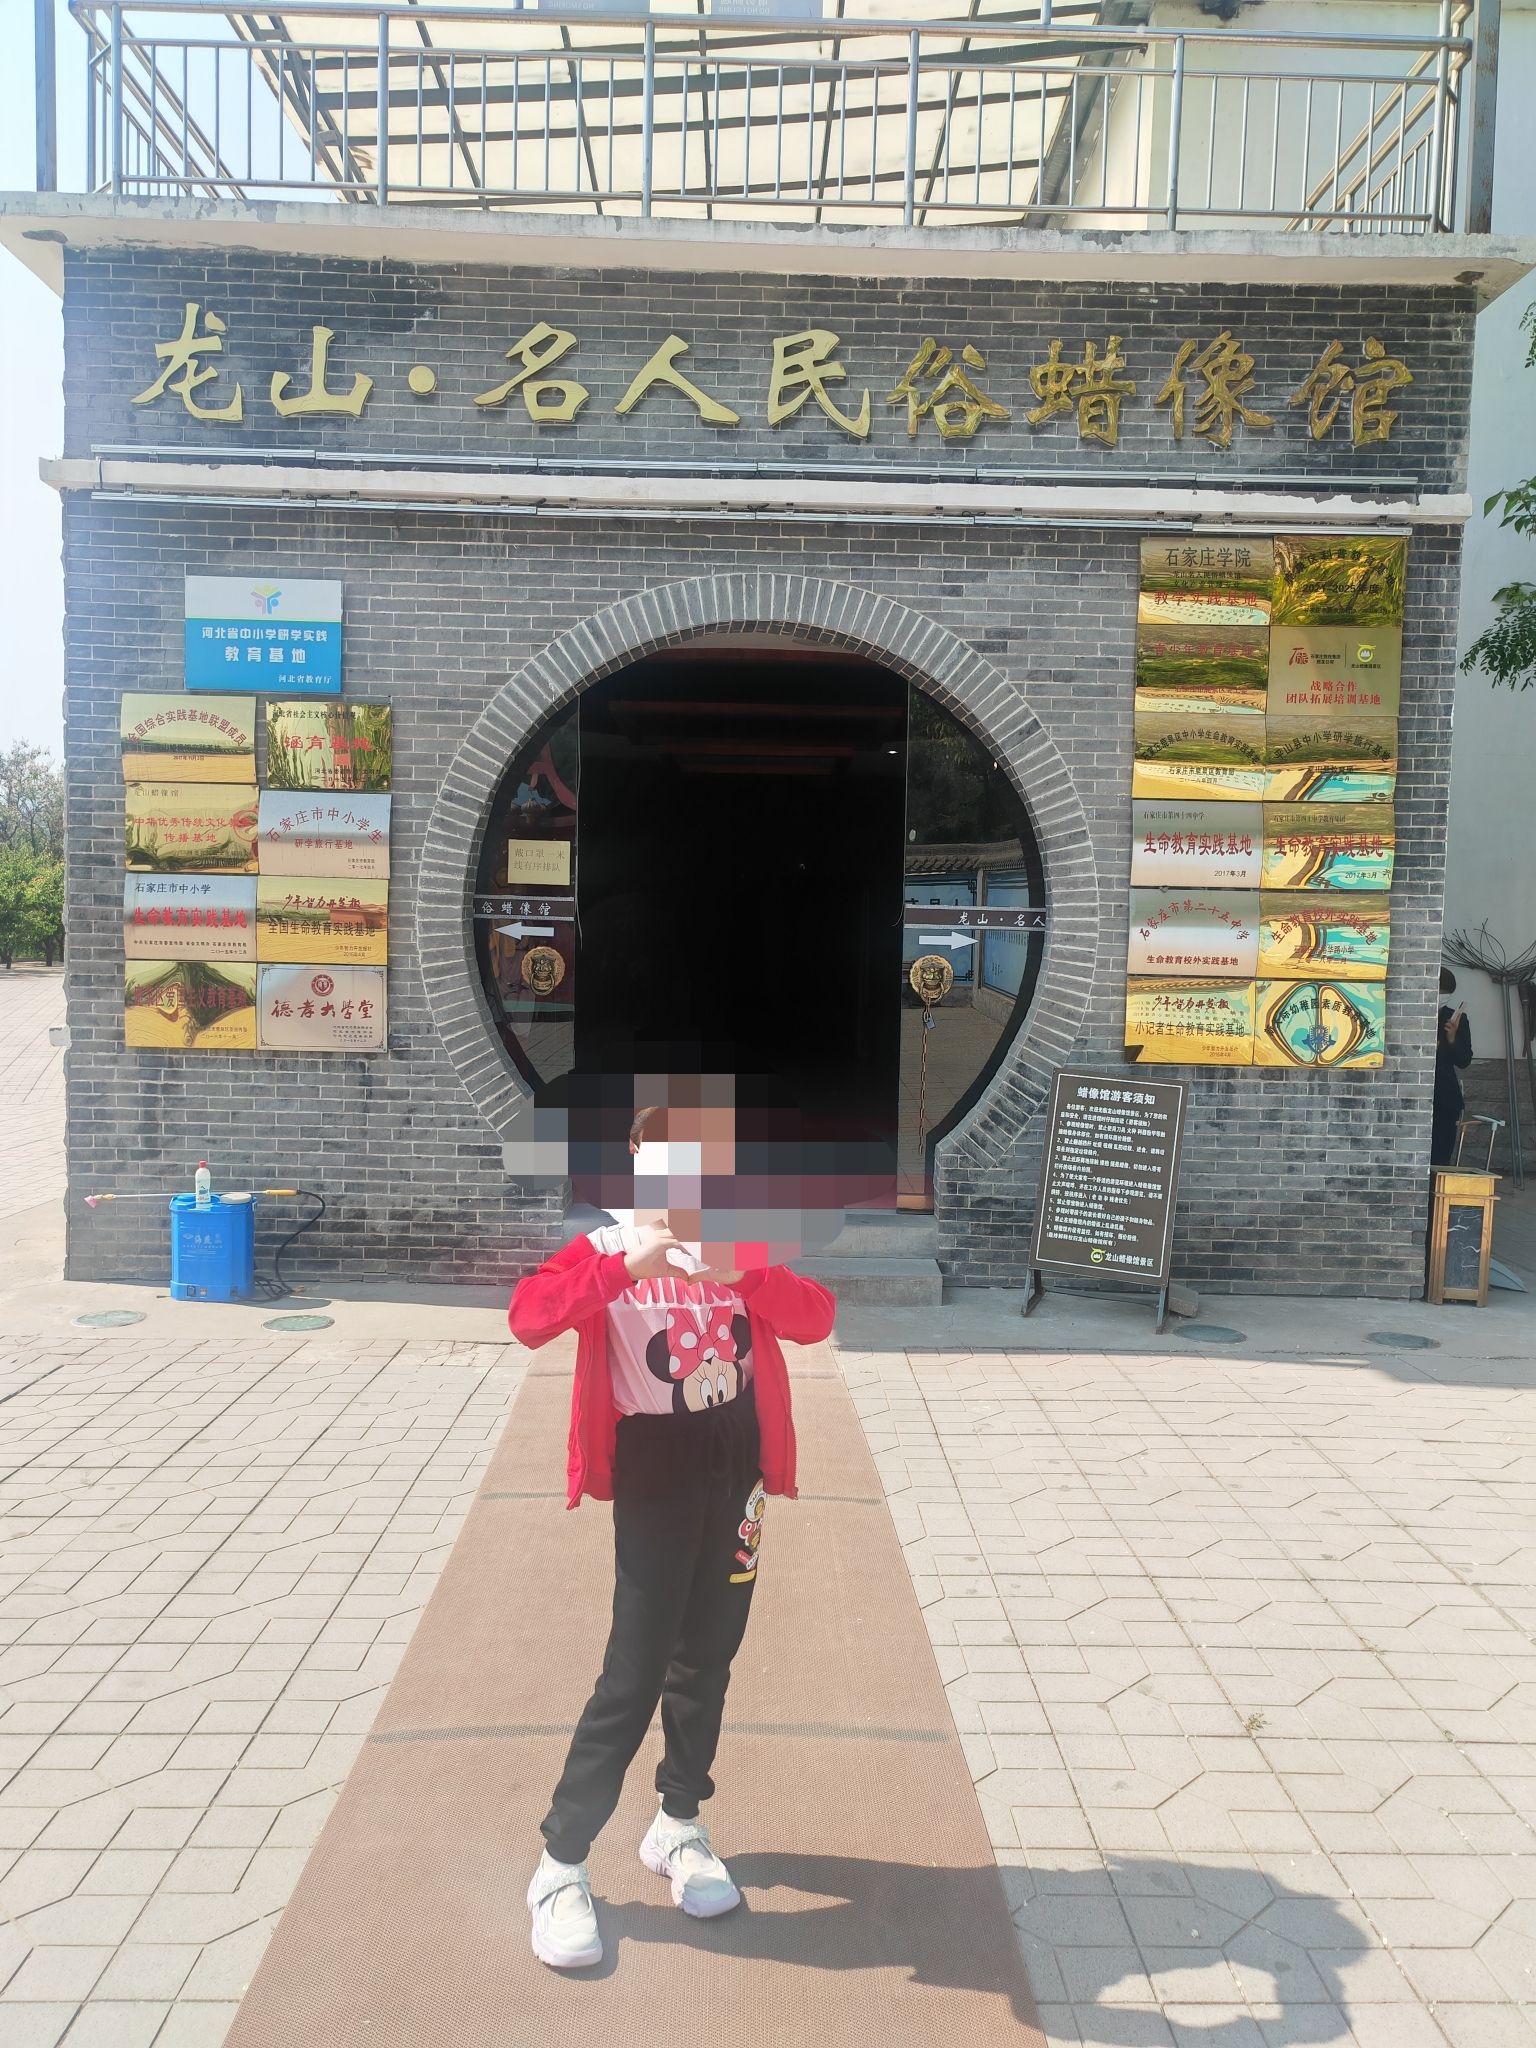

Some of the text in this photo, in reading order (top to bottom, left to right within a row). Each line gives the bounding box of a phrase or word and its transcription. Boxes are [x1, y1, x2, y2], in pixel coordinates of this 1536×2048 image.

[1165, 547, 1251, 568] 石家庄学院
[1154, 590, 1257, 607] 教学实践基地
[201, 626, 328, 642] 河北省中小学研学实践
[225, 646, 306, 664] 教育基地
[278, 674, 332, 685] 河北省教育厅
[1310, 681, 1357, 692] 战略合作
[1286, 692, 1381, 705] 团队拓展培训基地
[127, 708, 247, 746] 全国综合实践基地联盟成员
[1273, 731, 1391, 762] 平山县中小学研学旅行基地
[265, 806, 383, 846] 石家庄市中小学生
[164, 833, 217, 843] 传播基地
[295, 838, 354, 850] 研学旅行基地
[1143, 831, 1253, 857] 生命教育实践基地
[1273, 833, 1384, 858] 生命教育实践基地
[1214, 870, 1246, 878] 2017年3月
[135, 882, 212, 895] 石家庄市中小学
[482, 901, 551, 915] 俗蜡像馆
[133, 906, 248, 929] 生命教育实践基地
[1139, 898, 1250, 941] 石家庄市第二十五中学
[268, 919, 376, 937] 全国生命教育实践基地
[1270, 908, 1377, 946] 生命教育校外实践基地
[1146, 955, 1239, 966] 生命教育校外实践基地
[1135, 1020, 1245, 1037] 小记者生命教育实践基地
[1077, 1086, 1156, 1105] 蜡像馆游客须知
[1104, 1252, 1154, 1267] 龙山蜡像馆景区
